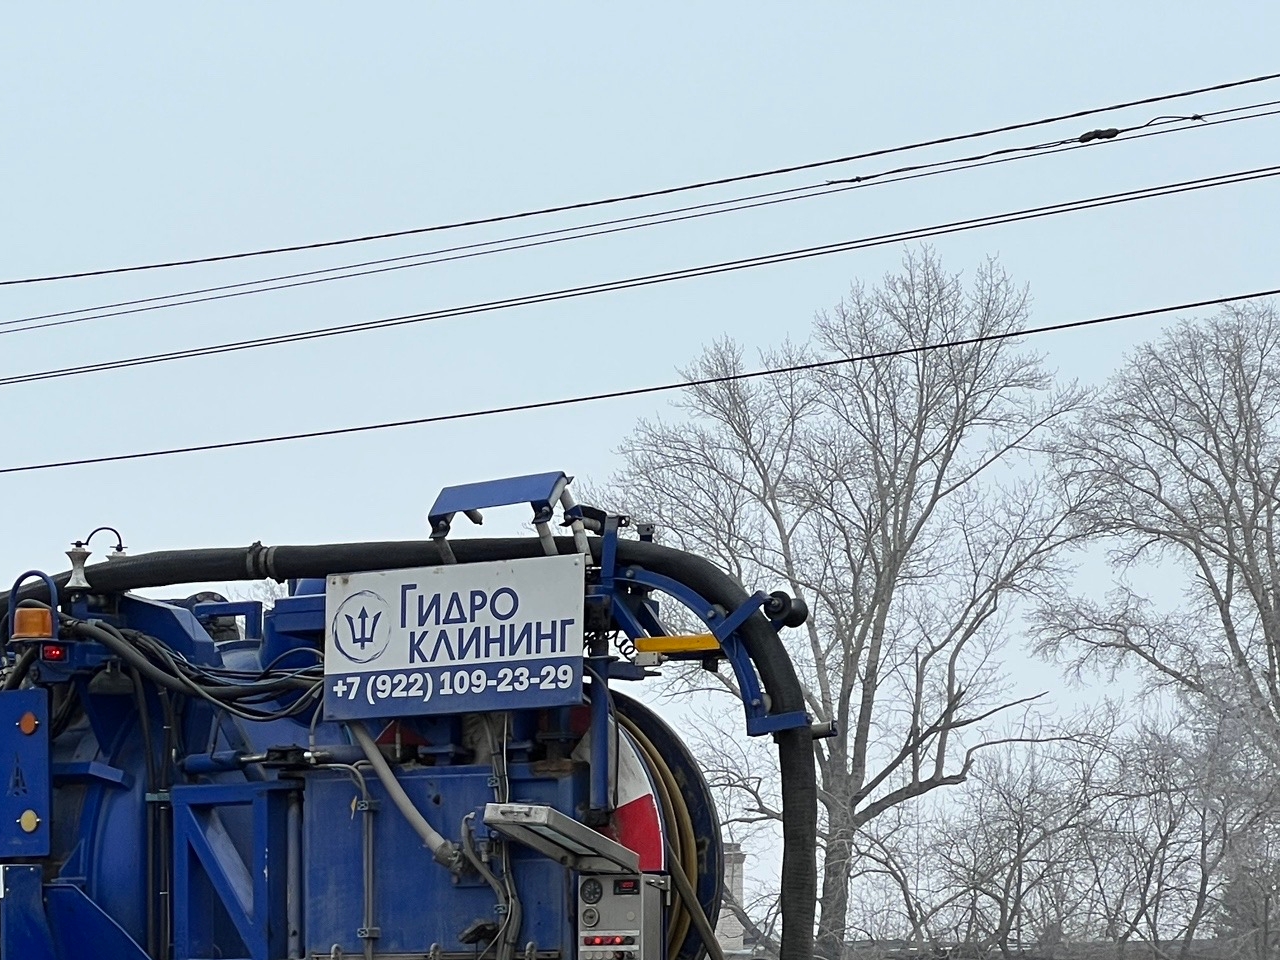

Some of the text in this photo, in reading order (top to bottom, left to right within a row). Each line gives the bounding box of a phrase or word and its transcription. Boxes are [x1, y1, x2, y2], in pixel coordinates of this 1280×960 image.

[409, 619, 575, 663] КЛИНИНГ
[333, 665, 574, 704] +7 (922) 109-23-29
